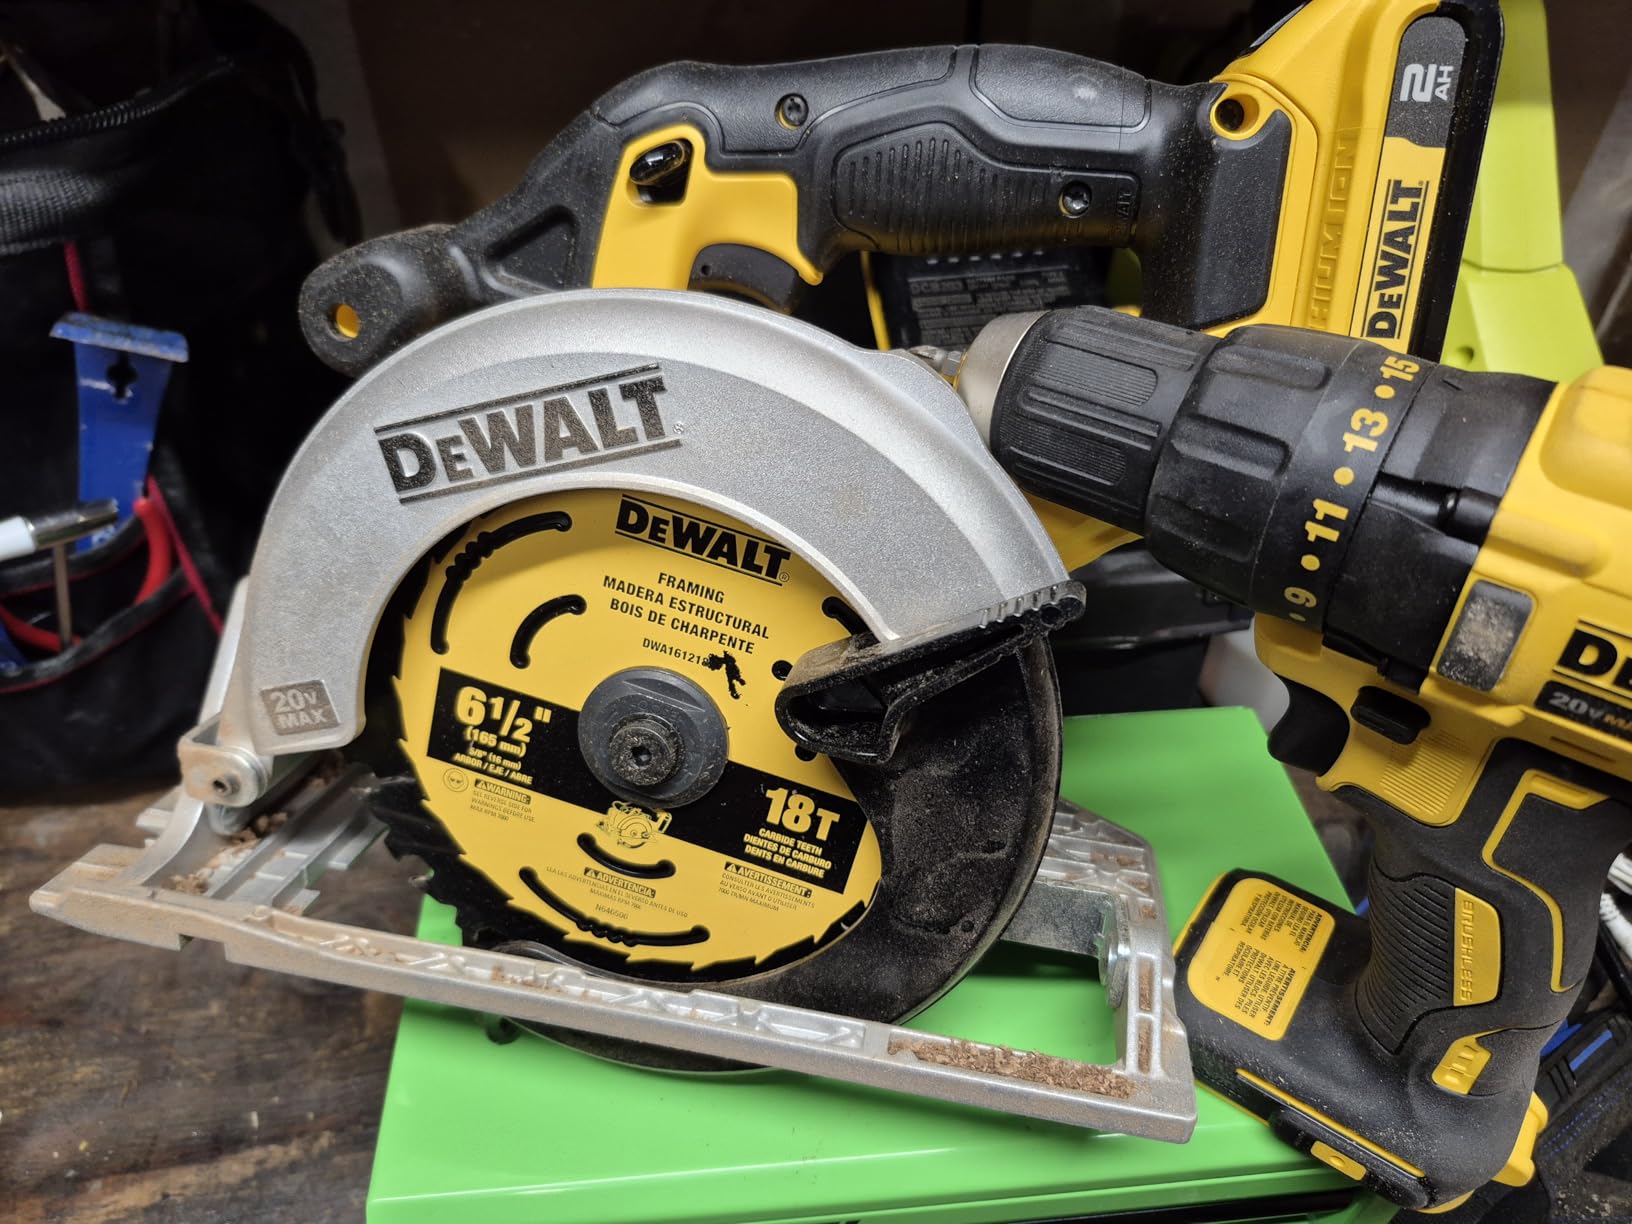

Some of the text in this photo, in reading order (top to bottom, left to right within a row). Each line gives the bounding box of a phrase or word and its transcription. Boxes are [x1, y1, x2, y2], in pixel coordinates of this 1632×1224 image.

[1400, 63, 1437, 102] 2
[1434, 65, 1454, 101] AH
[1366, 179, 1424, 339] DEWALT
[1379, 355, 1420, 383] 15
[378, 376, 668, 494] DEWALT
[1342, 408, 1389, 453] 13
[1304, 498, 1349, 542] 11
[616, 498, 791, 580] DEWALT
[658, 572, 726, 604] FRAMING
[1284, 586, 1317, 608] 9
[603, 575, 770, 639] MADERA ESTRUCTURAL
[610, 598, 755, 655] BOIS DE CHARPENTE
[278, 709, 328, 729] MAX
[465, 725, 527, 758] (165 mm)
[453, 752, 482, 768] ARBOR
[489, 763, 505, 776] EJE
[502, 757, 522, 771] mm)
[485, 782, 530, 803] WARNING:
[766, 787, 840, 841] 18T
[743, 833, 832, 870] DIENTES DE CARBURO
[758, 828, 823, 856] CARBIDE TEETH
[745, 845, 825, 878] DENTS EN CARBURE
[1461, 900, 1475, 1001] BRUSHLESS
